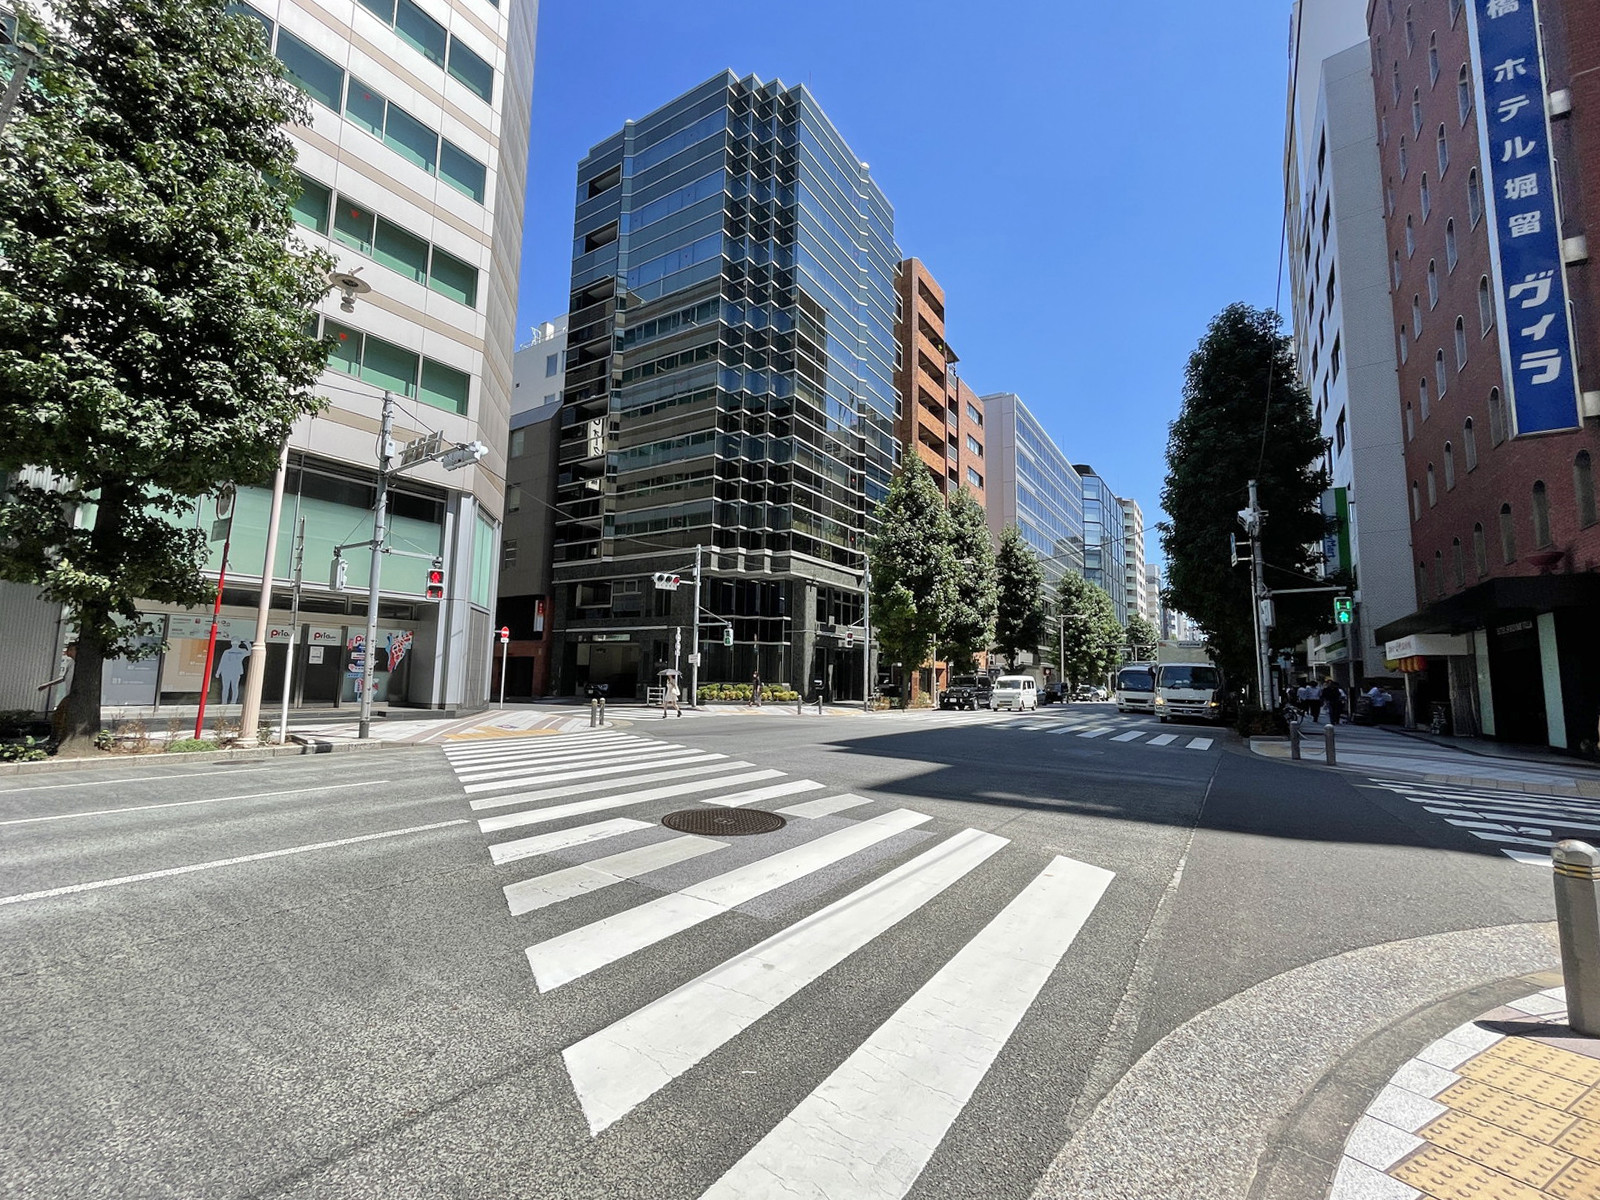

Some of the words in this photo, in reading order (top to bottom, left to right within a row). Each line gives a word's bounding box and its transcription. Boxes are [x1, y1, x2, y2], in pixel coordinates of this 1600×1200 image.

[1493, 58, 1541, 238] ホテル堀留
[1509, 269, 1562, 385] ヴィラ
